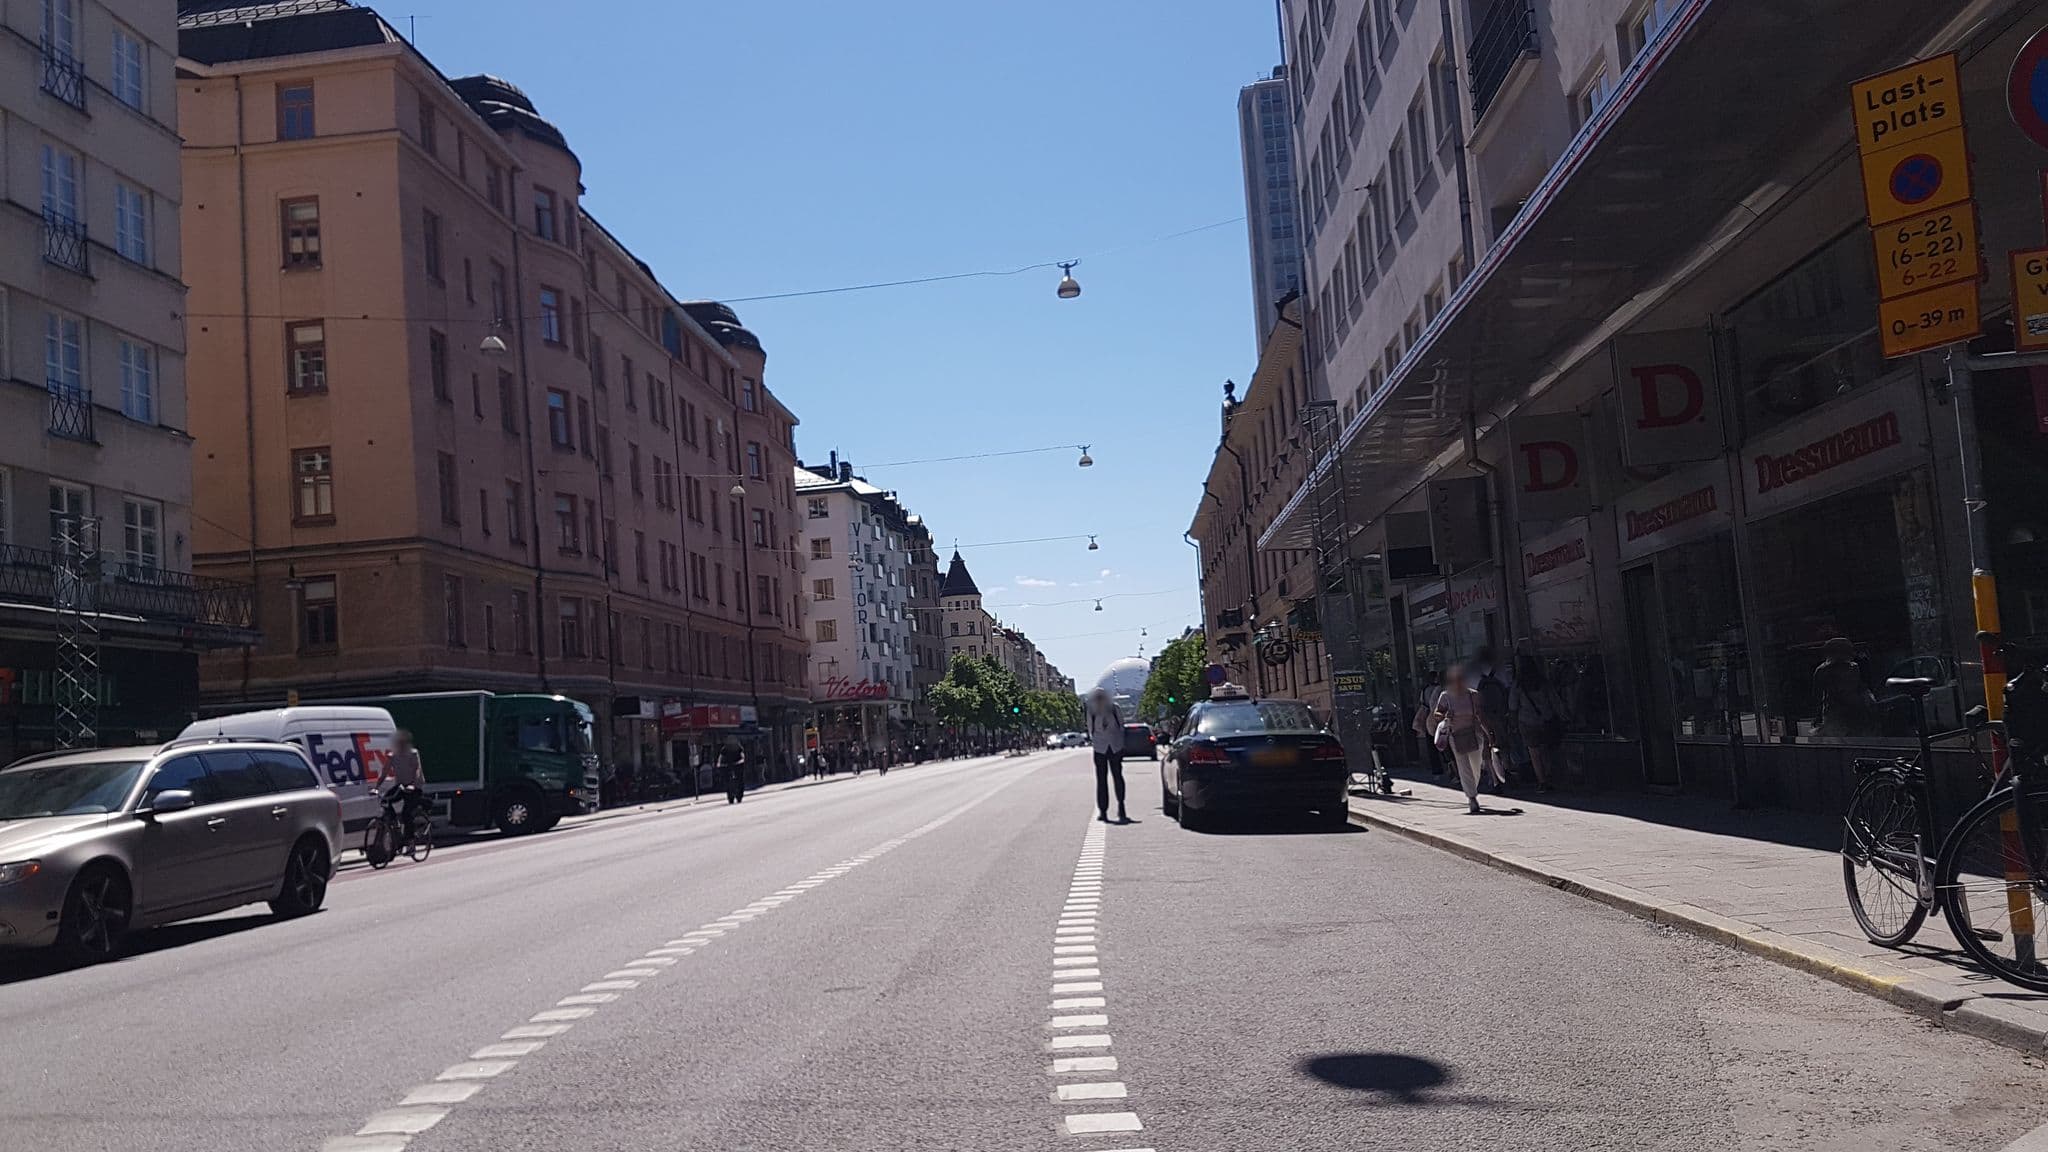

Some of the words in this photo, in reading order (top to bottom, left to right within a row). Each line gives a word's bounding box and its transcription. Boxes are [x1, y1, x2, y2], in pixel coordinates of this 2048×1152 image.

[1866, 74, 1944, 111] Last-
[1872, 101, 1946, 142] plats
[1897, 215, 1952, 244] 6-22
[1891, 232, 1963, 269] (6-22)
[1902, 258, 1957, 286] 6-22
[1892, 310, 1944, 336] 0-39
[1948, 307, 1965, 323] m
[1754, 410, 1901, 495] Dressmann
[1626, 484, 1719, 543] Dressmann
[1525, 537, 1586, 579] Dressmn
[852, 522, 871, 660] VICTORIA
[306, 732, 396, 783] FedEx
